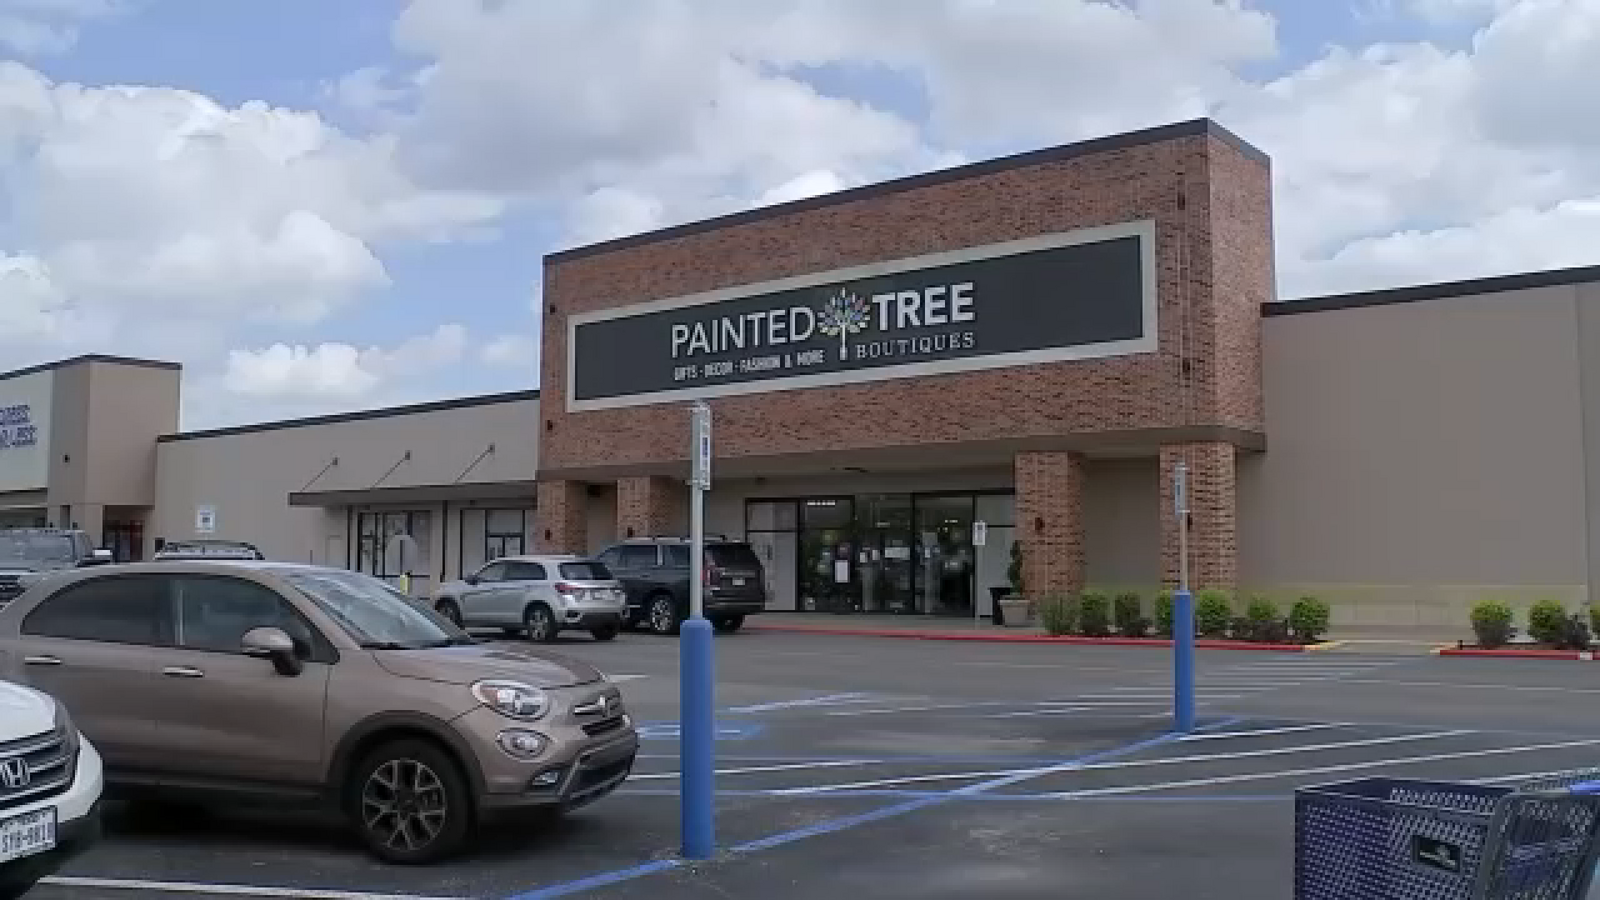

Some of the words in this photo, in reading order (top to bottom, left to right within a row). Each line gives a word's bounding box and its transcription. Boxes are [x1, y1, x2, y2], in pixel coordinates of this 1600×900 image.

[671, 306, 816, 358] PAINTED
[872, 282, 975, 331] TREE
[856, 332, 975, 359] BOUTIQUES
[704, 362, 733, 378] DECOR
[740, 357, 781, 374] FASHION
